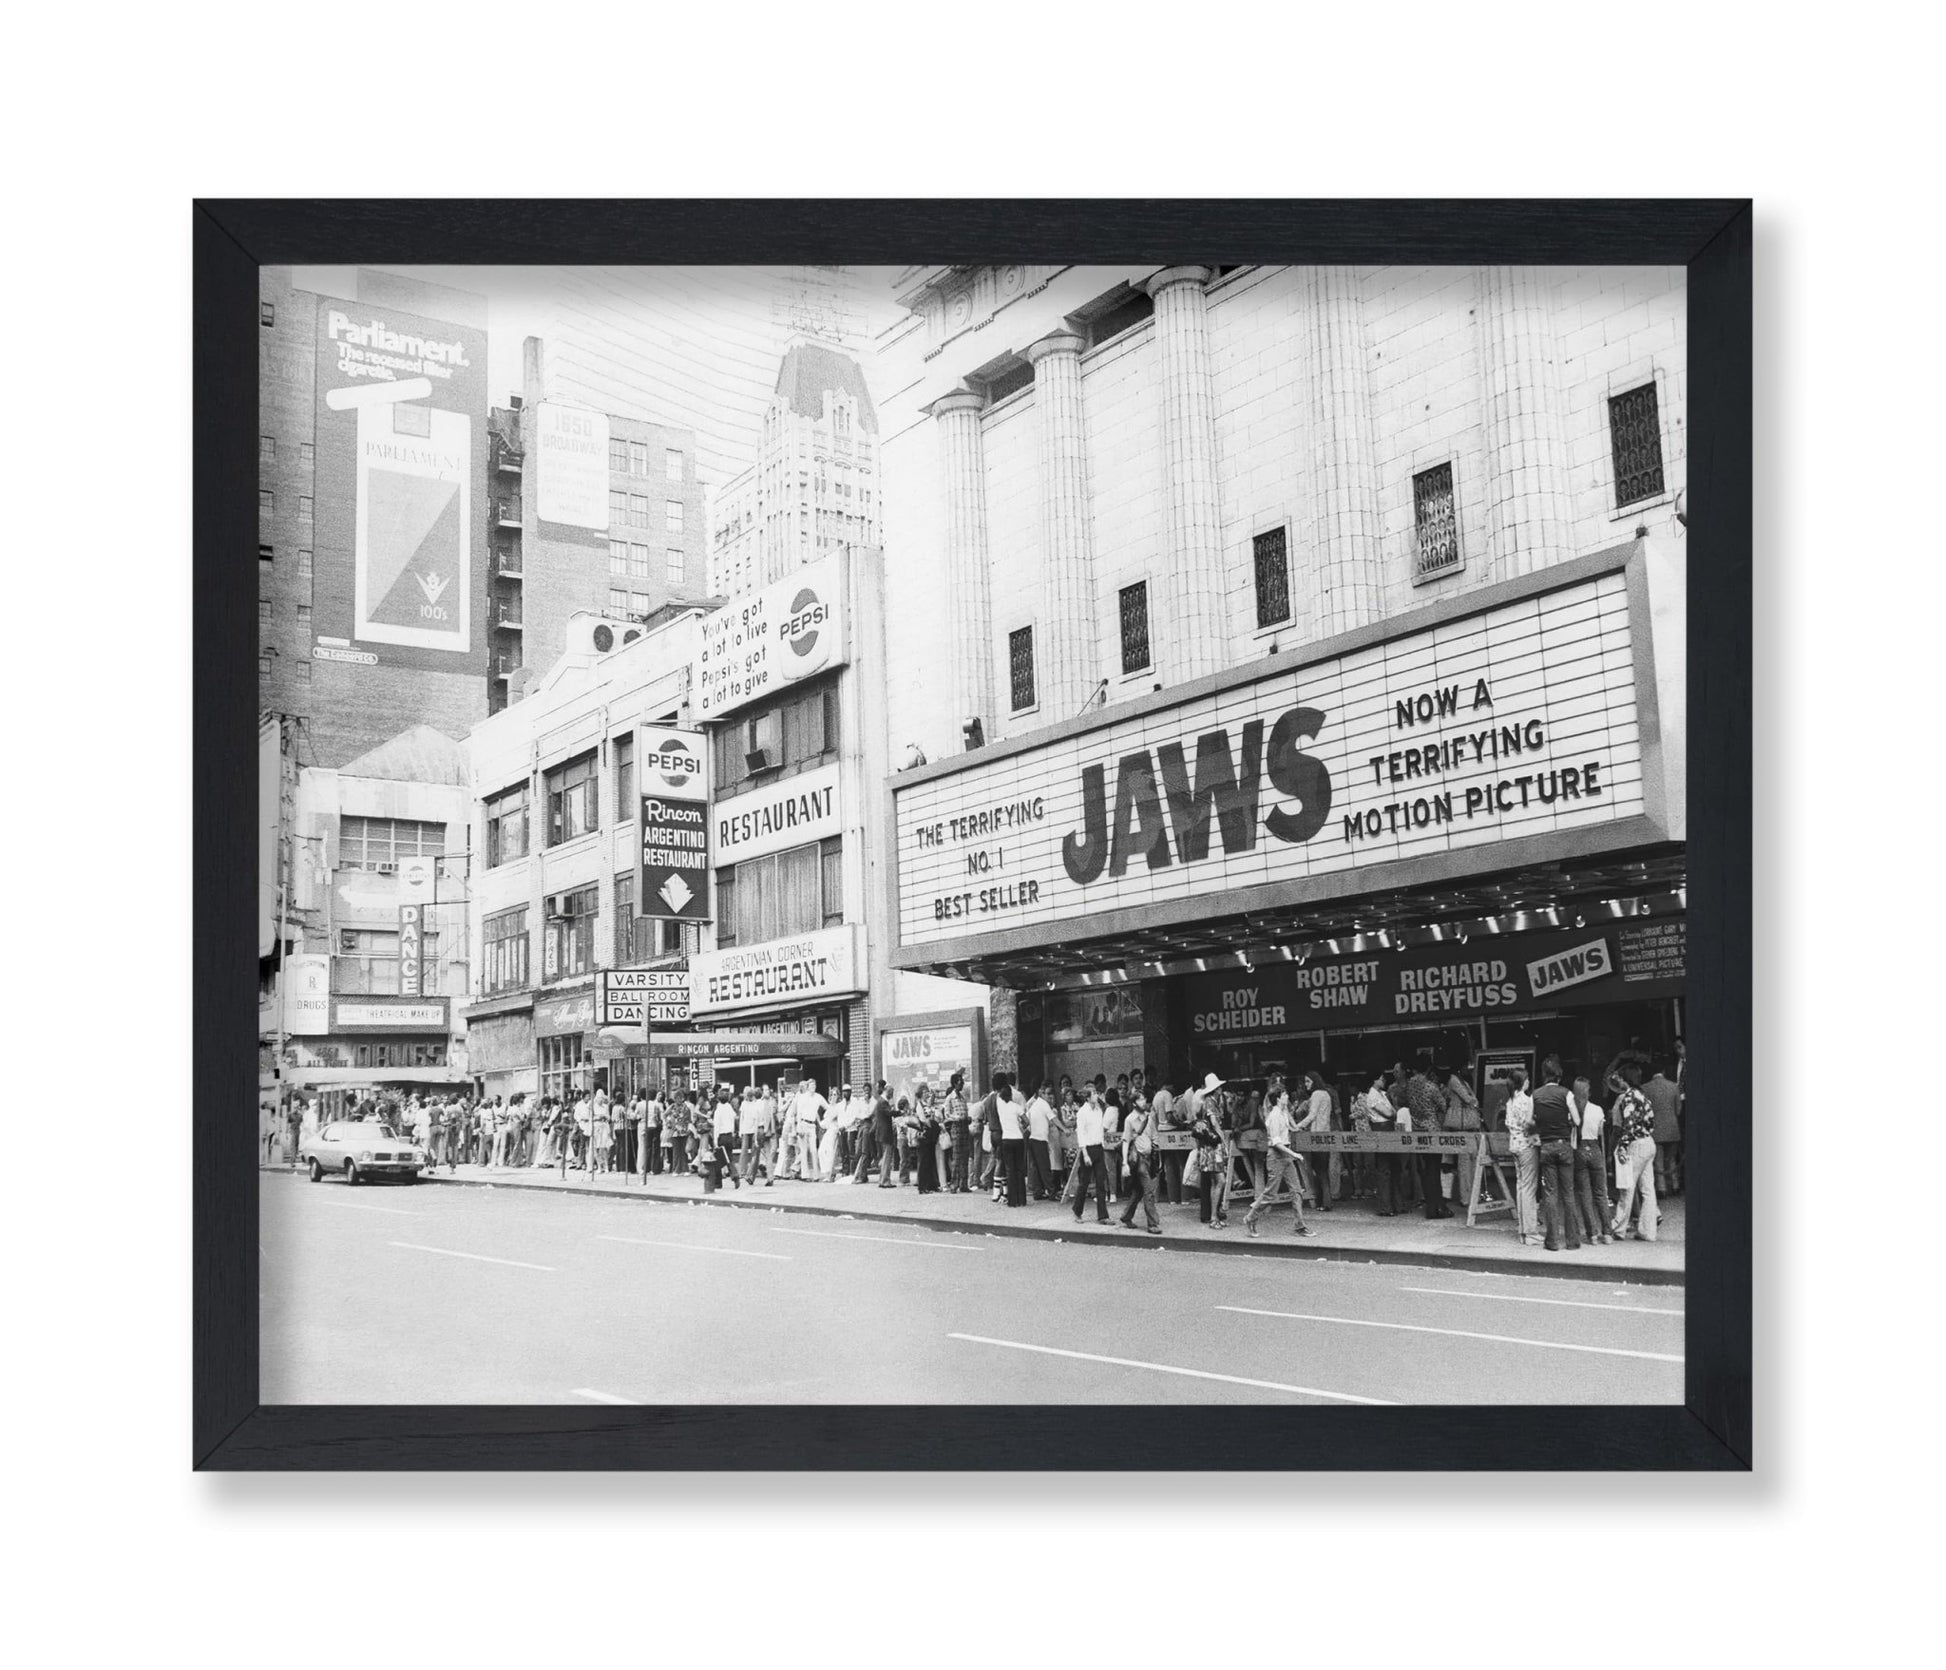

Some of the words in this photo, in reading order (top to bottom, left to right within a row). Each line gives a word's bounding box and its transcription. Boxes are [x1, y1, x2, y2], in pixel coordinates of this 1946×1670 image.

[555, 413, 592, 437] 1650
[542, 433, 603, 456] BROADWAY
[702, 614, 736, 641] You've
[742, 597, 763, 626] got
[779, 604, 829, 640] PEPSI
[701, 650, 708, 663] a
[713, 638, 726, 656] lot
[732, 633, 742, 647] to
[747, 621, 767, 641] live
[746, 645, 766, 673] got
[702, 696, 709, 709] a
[713, 688, 726, 705] lot
[731, 683, 740, 696] to
[744, 669, 768, 696] give
[1396, 684, 1458, 730] NOW
[1473, 677, 1494, 711] A
[648, 753, 701, 774] PEPSI
[1369, 719, 1544, 786] TERRIFYING
[1062, 707, 1331, 885] JAWS
[1344, 792, 1453, 843] MOTION
[1465, 761, 1602, 820] PICTURE
[645, 799, 703, 823] Rincon
[720, 786, 833, 848] RESTAURANT
[917, 827, 943, 849] THE
[949, 796, 1045, 842] TERRIFYING
[644, 826, 705, 848] ARGENTINO
[643, 848, 707, 869] RESTAURANT
[968, 850, 993, 876] NO.
[935, 893, 971, 921] BEST
[979, 880, 1039, 913] SELLER
[401, 906, 418, 994] DANCE
[778, 941, 813, 963] CORNER
[615, 974, 685, 986] VARSITY
[709, 958, 827, 1003] RESTAURANT
[1297, 961, 1379, 990] ROBERT
[1400, 960, 1507, 992] RICHARD
[1533, 945, 1605, 993] JAWS
[297, 1000, 327, 1010] DRUGS
[610, 992, 689, 1002] BALLROOM
[1223, 987, 1259, 1010] ROY
[1309, 984, 1368, 1009] SHAW
[1395, 983, 1517, 1014] DREYFUSS
[614, 1007, 687, 1019] DANCING
[1194, 1005, 1286, 1033] SCHEIDER
[679, 1044, 709, 1055] RINCON
[714, 1044, 759, 1054] ARGENTINO
[892, 1035, 931, 1059] JAWS
[1310, 1136, 1336, 1145] POLICE
[1342, 1135, 1358, 1145] LINE
[1402, 1136, 1412, 1145] DO
[1418, 1136, 1432, 1146] NOT
[1439, 1136, 1466, 1146] CROSS
